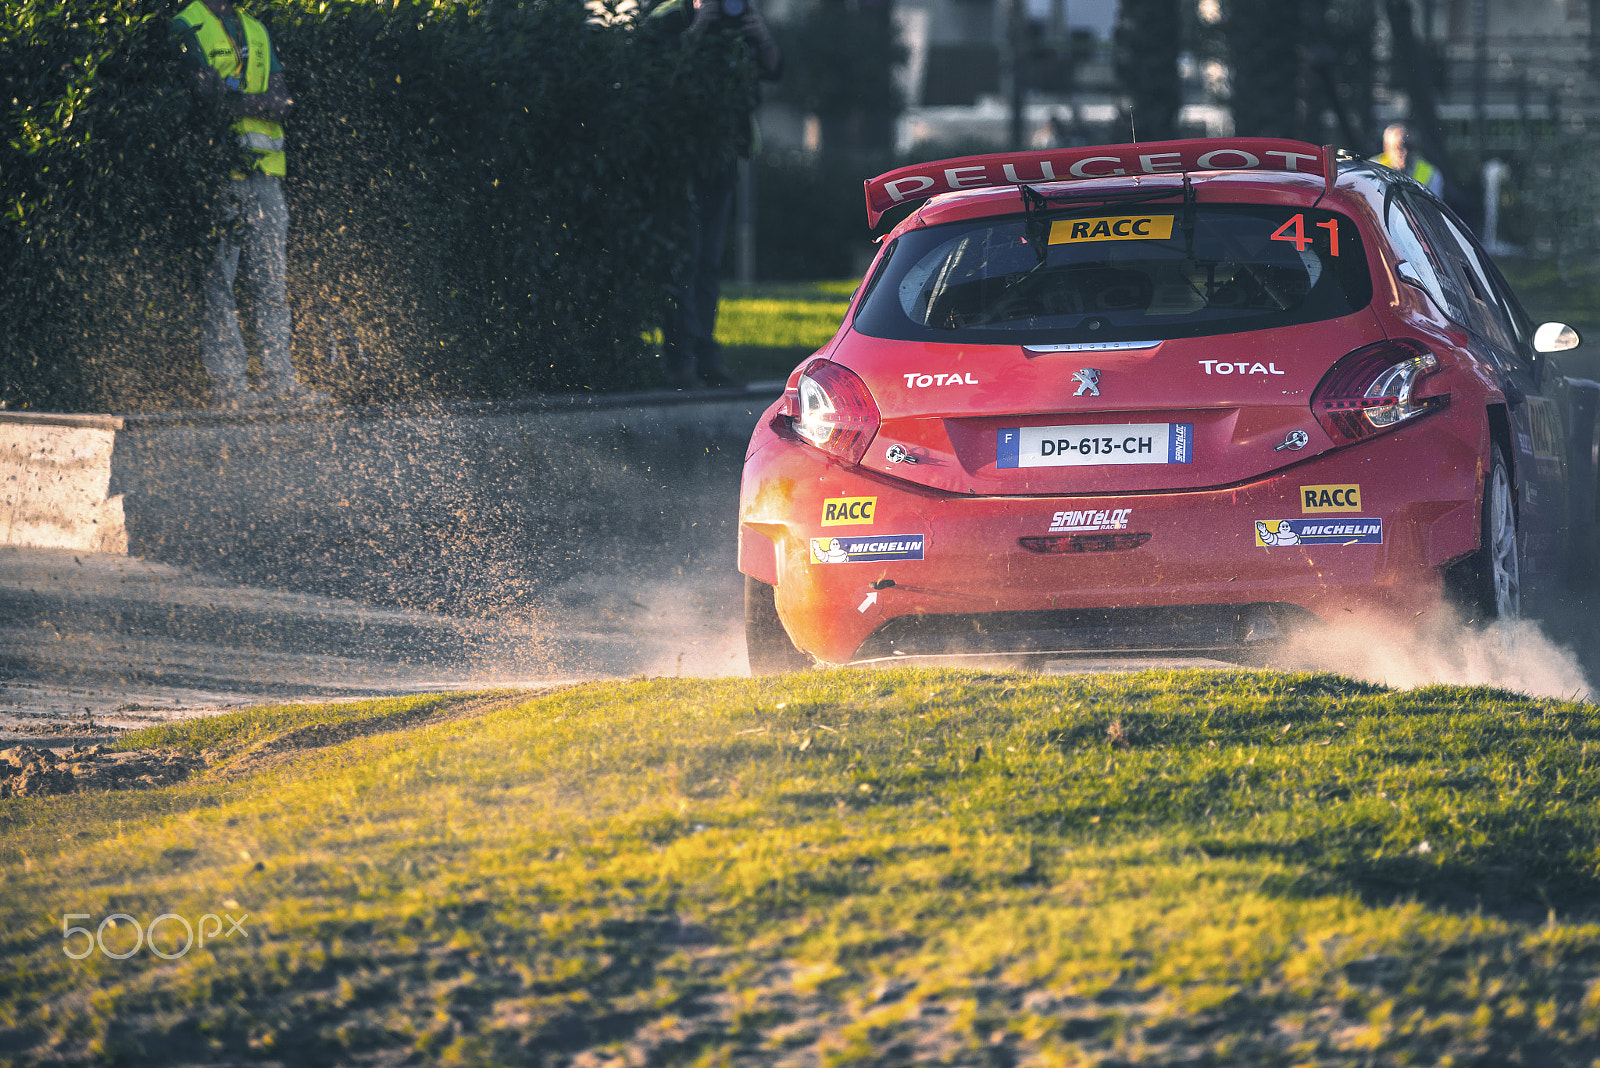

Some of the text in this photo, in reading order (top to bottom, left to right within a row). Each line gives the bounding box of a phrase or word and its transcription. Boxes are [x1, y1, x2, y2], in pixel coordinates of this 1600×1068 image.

[883, 148, 1318, 202] PEUGEOT
[1070, 218, 1152, 239] RACC
[1270, 213, 1339, 257] 41
[1053, 342, 1132, 350] PEUGEOT
[1198, 359, 1285, 375] TOTAL
[903, 372, 979, 389] TOTAL
[1004, 433, 1013, 444] F
[1041, 436, 1153, 457] DP-613-CH
[1304, 488, 1358, 508] RACC
[825, 501, 873, 521] RACC
[1301, 525, 1381, 535] MICHELIN
[848, 541, 923, 553] MICHELIN
